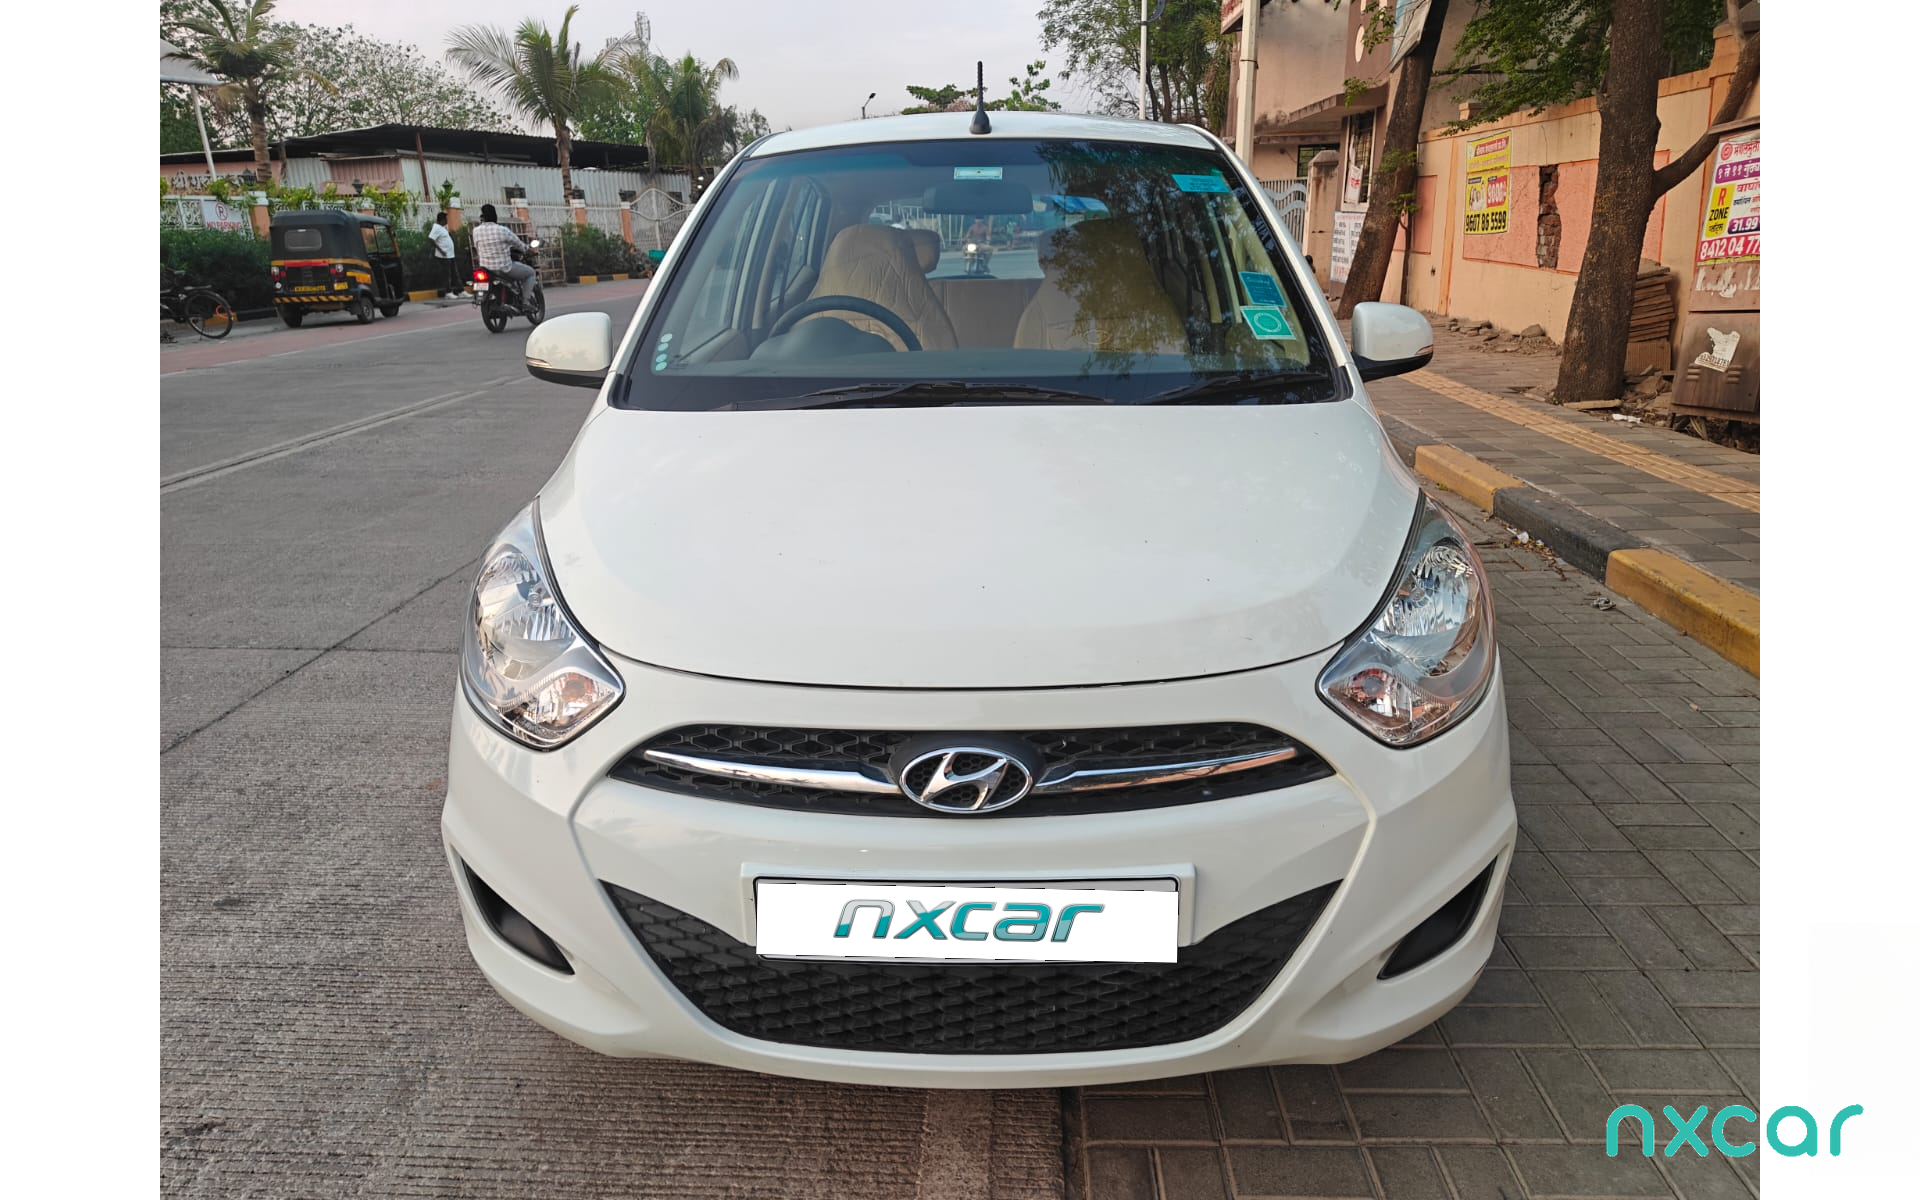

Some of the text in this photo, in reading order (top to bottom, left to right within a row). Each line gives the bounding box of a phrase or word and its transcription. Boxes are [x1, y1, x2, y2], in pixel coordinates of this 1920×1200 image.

[1718, 187, 1727, 206] R
[1710, 207, 1729, 221] ZONE
[1731, 216, 1759, 233] 31.99
[1701, 235, 1760, 260] 8412 04 77
